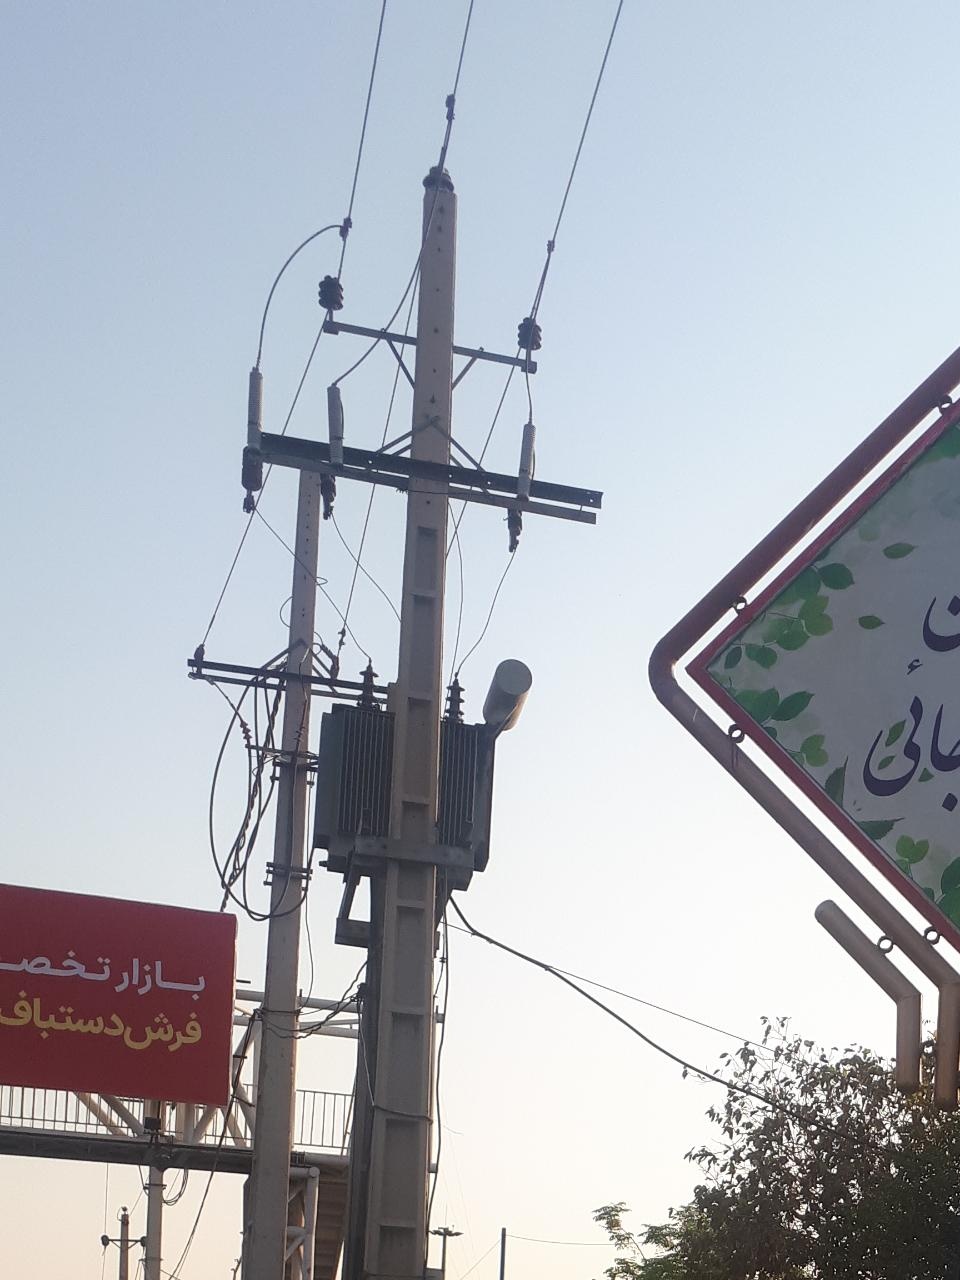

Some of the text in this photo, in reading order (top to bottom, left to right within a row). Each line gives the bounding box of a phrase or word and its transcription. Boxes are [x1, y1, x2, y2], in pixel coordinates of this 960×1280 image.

[0, 950, 206, 1001] بازار تخص
[0, 989, 202, 1052] فرش دستباف
